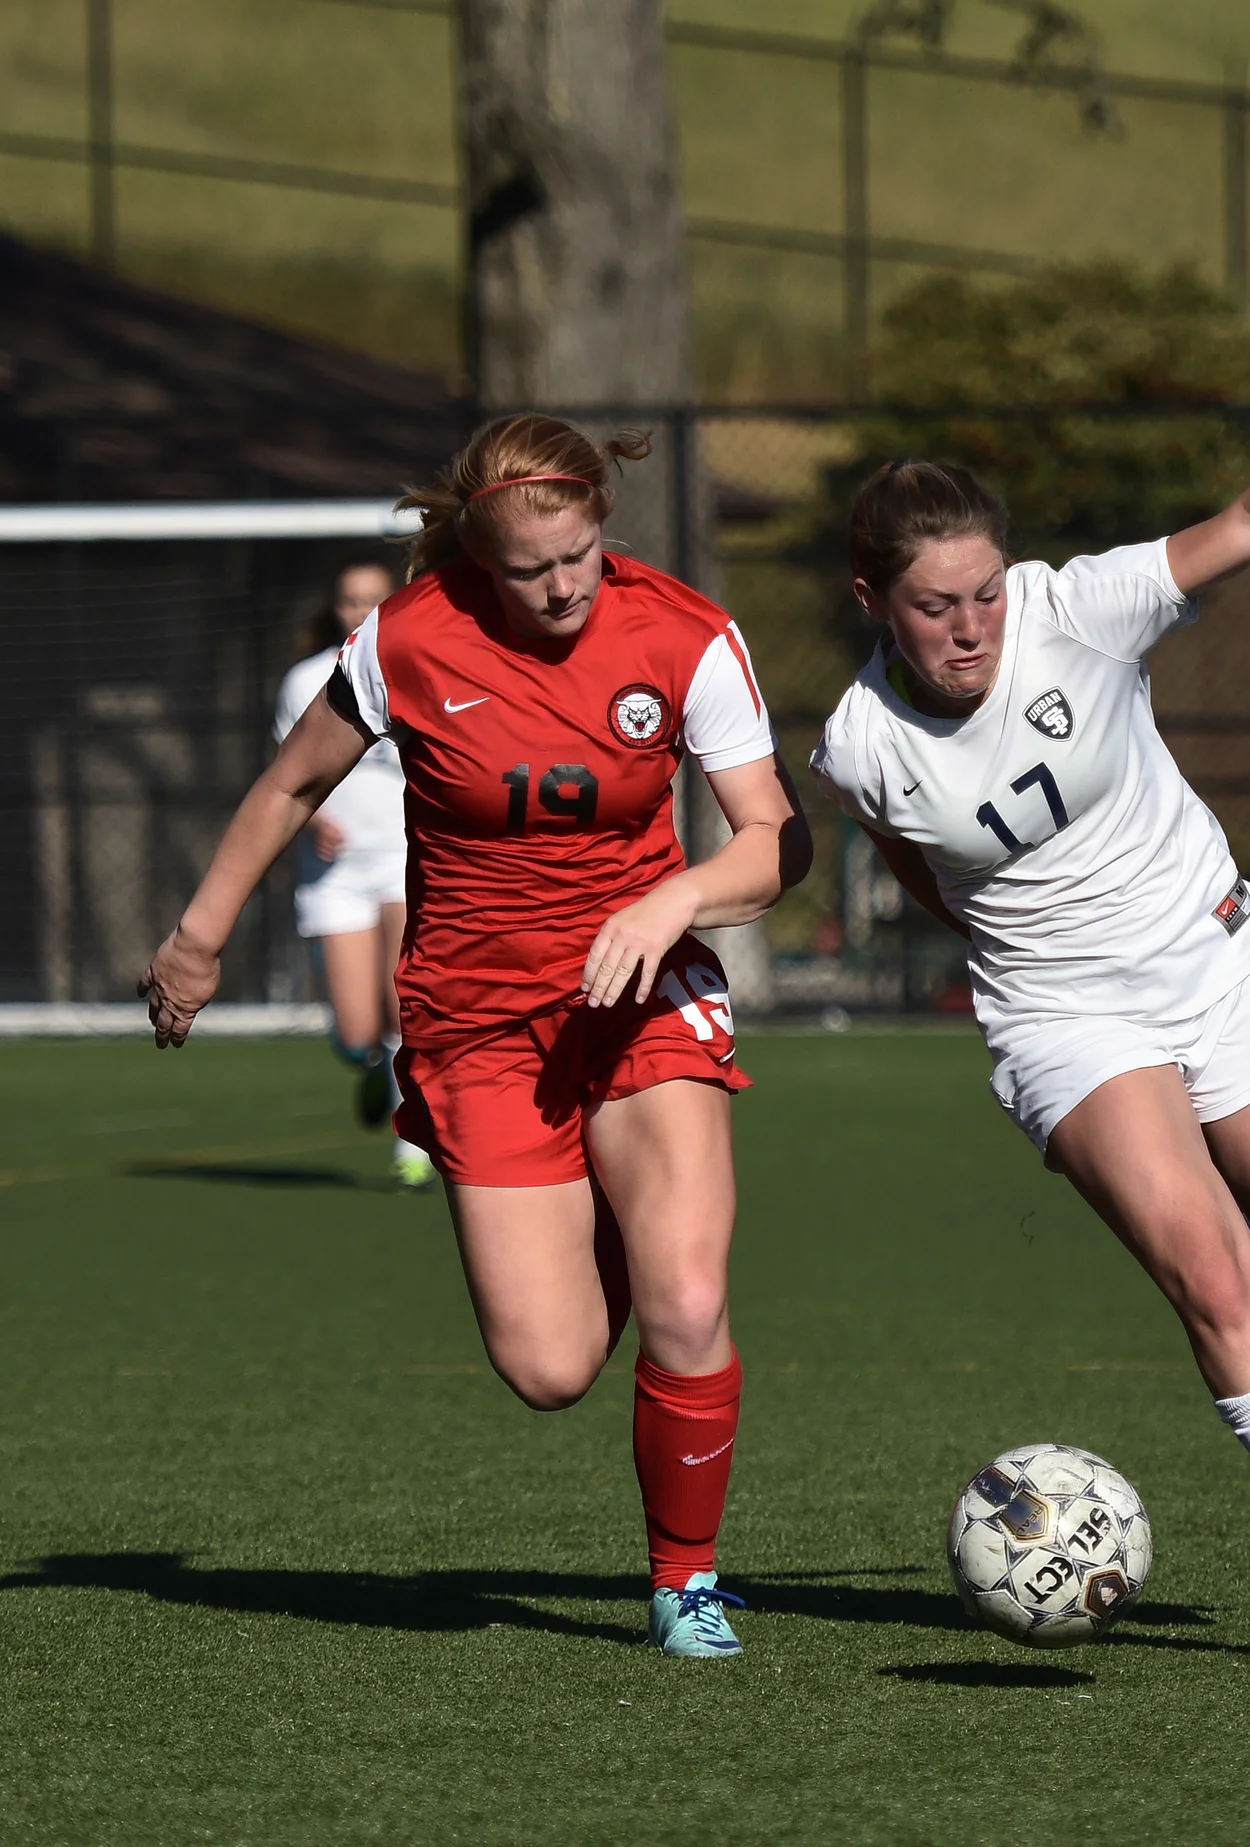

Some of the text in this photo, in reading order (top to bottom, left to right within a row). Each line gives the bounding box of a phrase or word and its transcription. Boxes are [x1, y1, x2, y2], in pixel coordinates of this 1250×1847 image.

[1028, 691, 1062, 722] URBAN
[501, 763, 599, 833] 19
[976, 761, 1069, 857] 17
[1235, 885, 1246, 899] M
[655, 962, 735, 1041] 19
[1016, 1507, 1045, 1535] REAL
